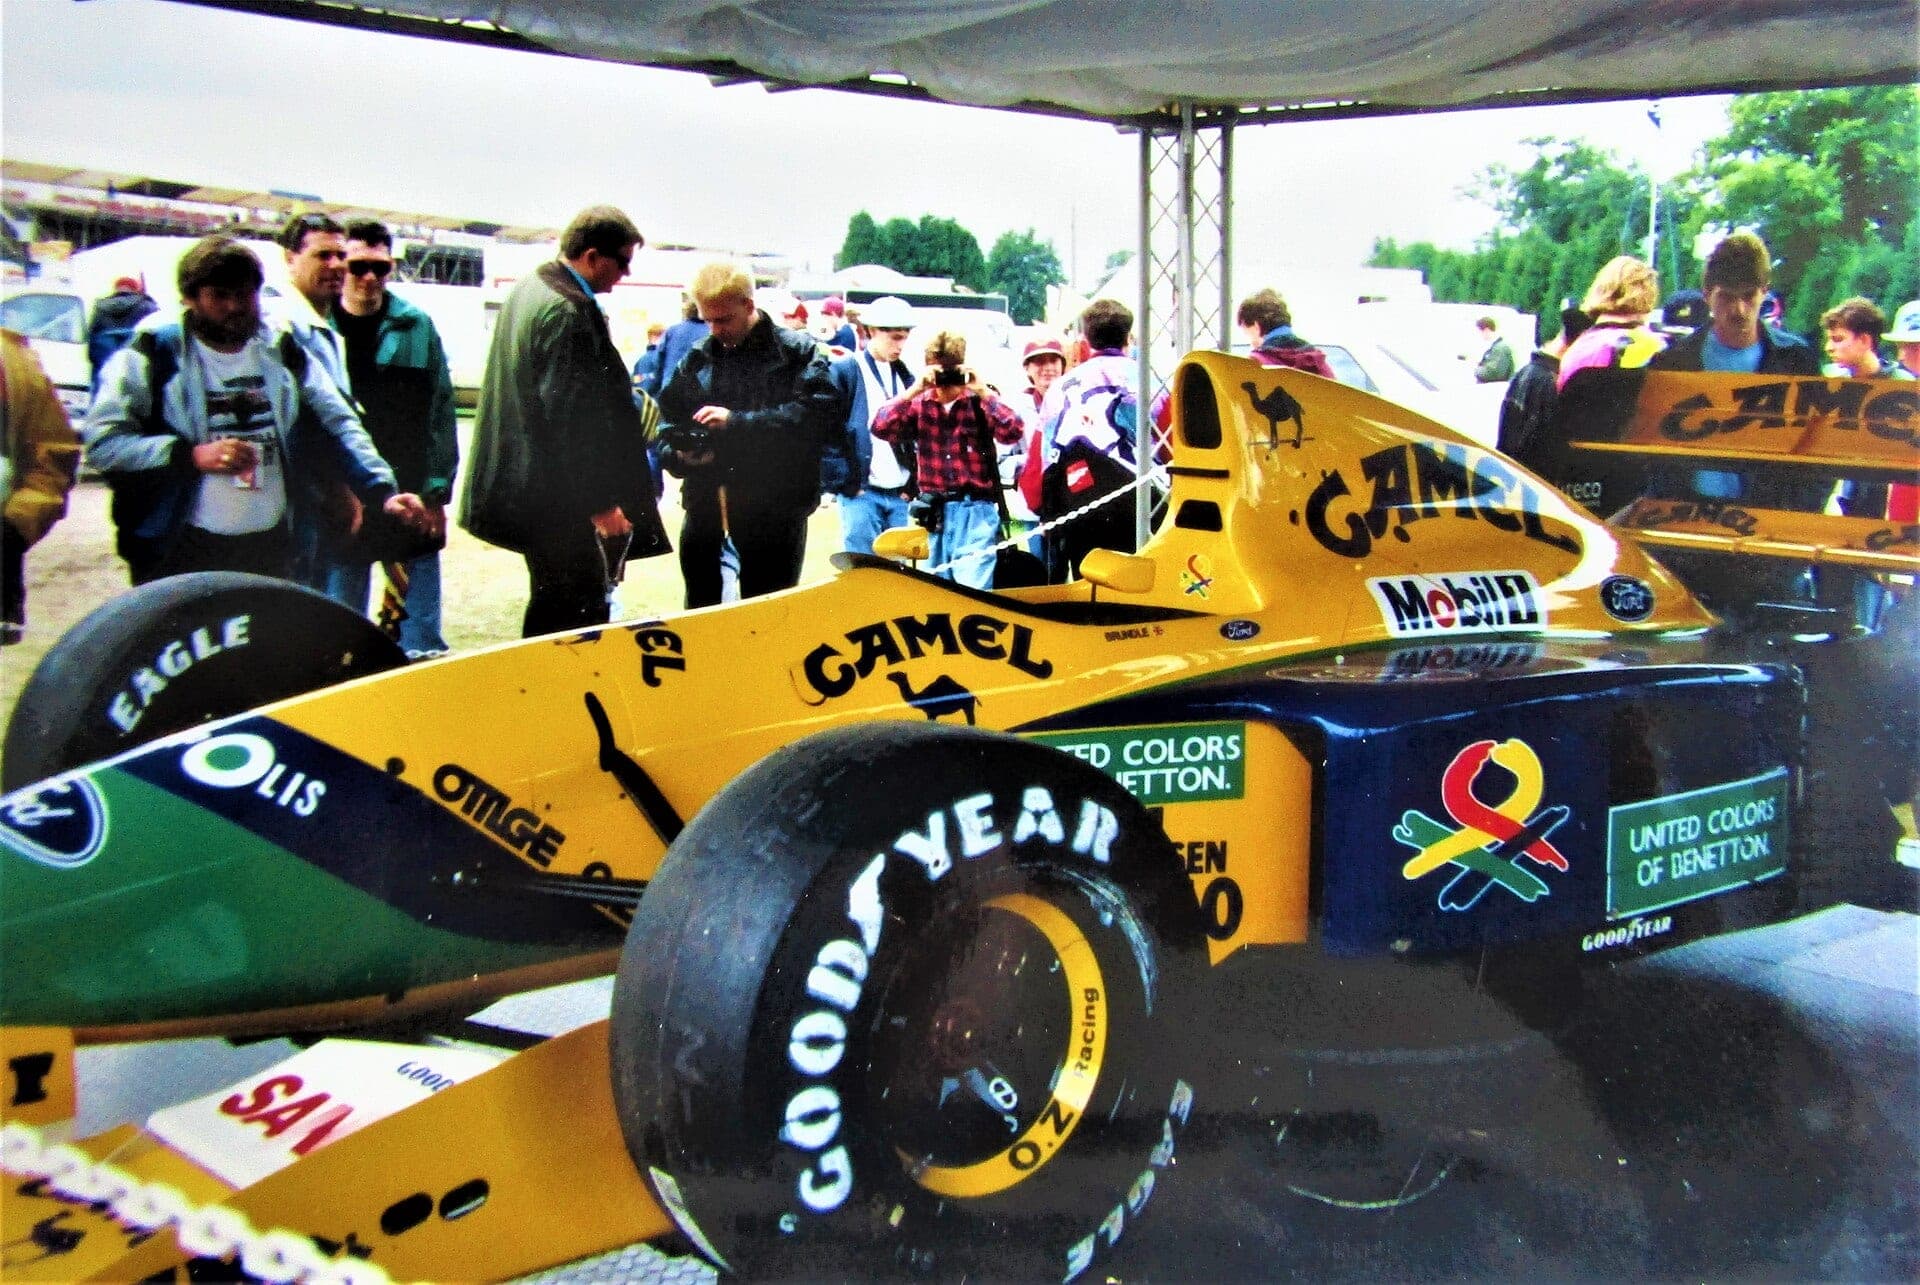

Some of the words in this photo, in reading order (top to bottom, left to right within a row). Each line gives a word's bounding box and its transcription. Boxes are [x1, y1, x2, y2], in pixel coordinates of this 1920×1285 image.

[1306, 442, 1582, 558] CAMEL
[1225, 621, 1257, 639] Ford
[1378, 576, 1504, 631] Mobil
[107, 614, 251, 733] EAGLE
[804, 613, 1053, 697] CAMEL
[1122, 735, 1241, 767] COLORS
[1629, 814, 1700, 853] UNITED
[1707, 797, 1776, 834] COLORS
[1636, 855, 1664, 887] OF
[1582, 916, 1673, 951] GOODYEAR
[1074, 987, 1101, 1079] Racing
[219, 1074, 354, 1156] SAN
